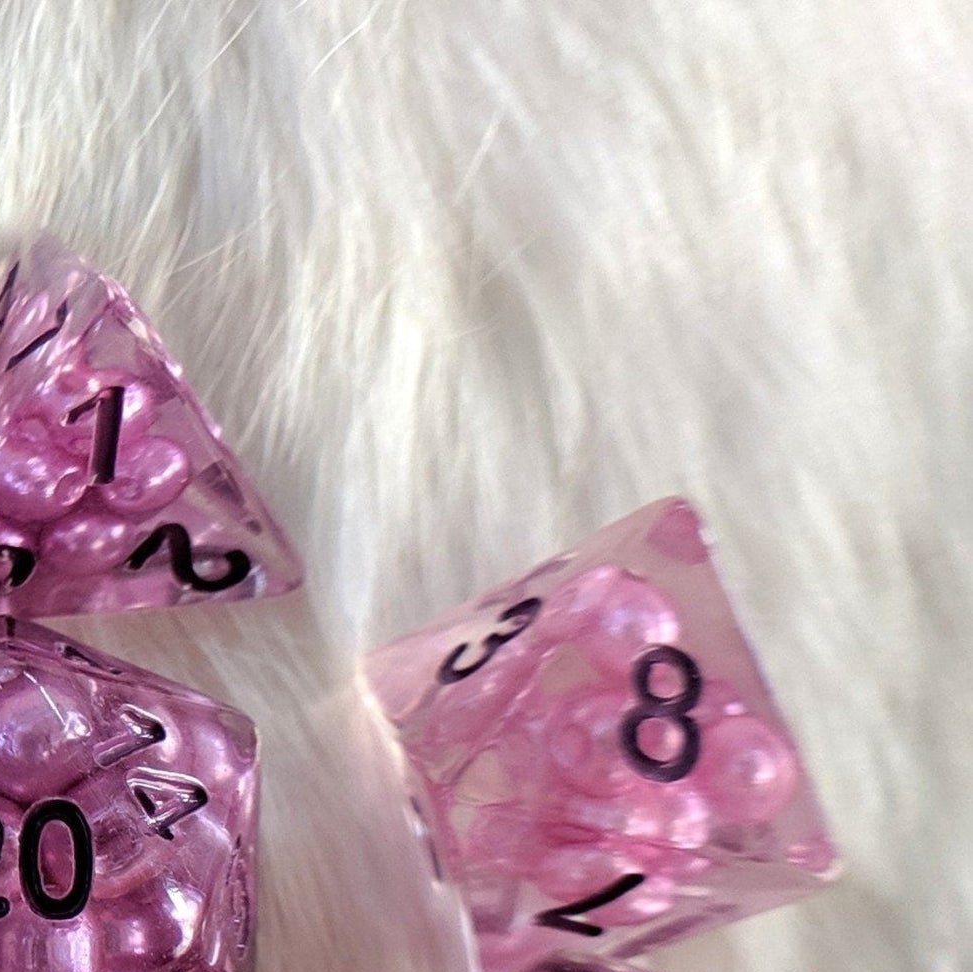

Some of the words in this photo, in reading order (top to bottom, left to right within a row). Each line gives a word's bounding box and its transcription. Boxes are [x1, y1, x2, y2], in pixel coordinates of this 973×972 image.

[60, 386, 126, 486] 1
[128, 523, 252, 592] 2
[438, 597, 543, 685] 3
[620, 644, 704, 783] 8
